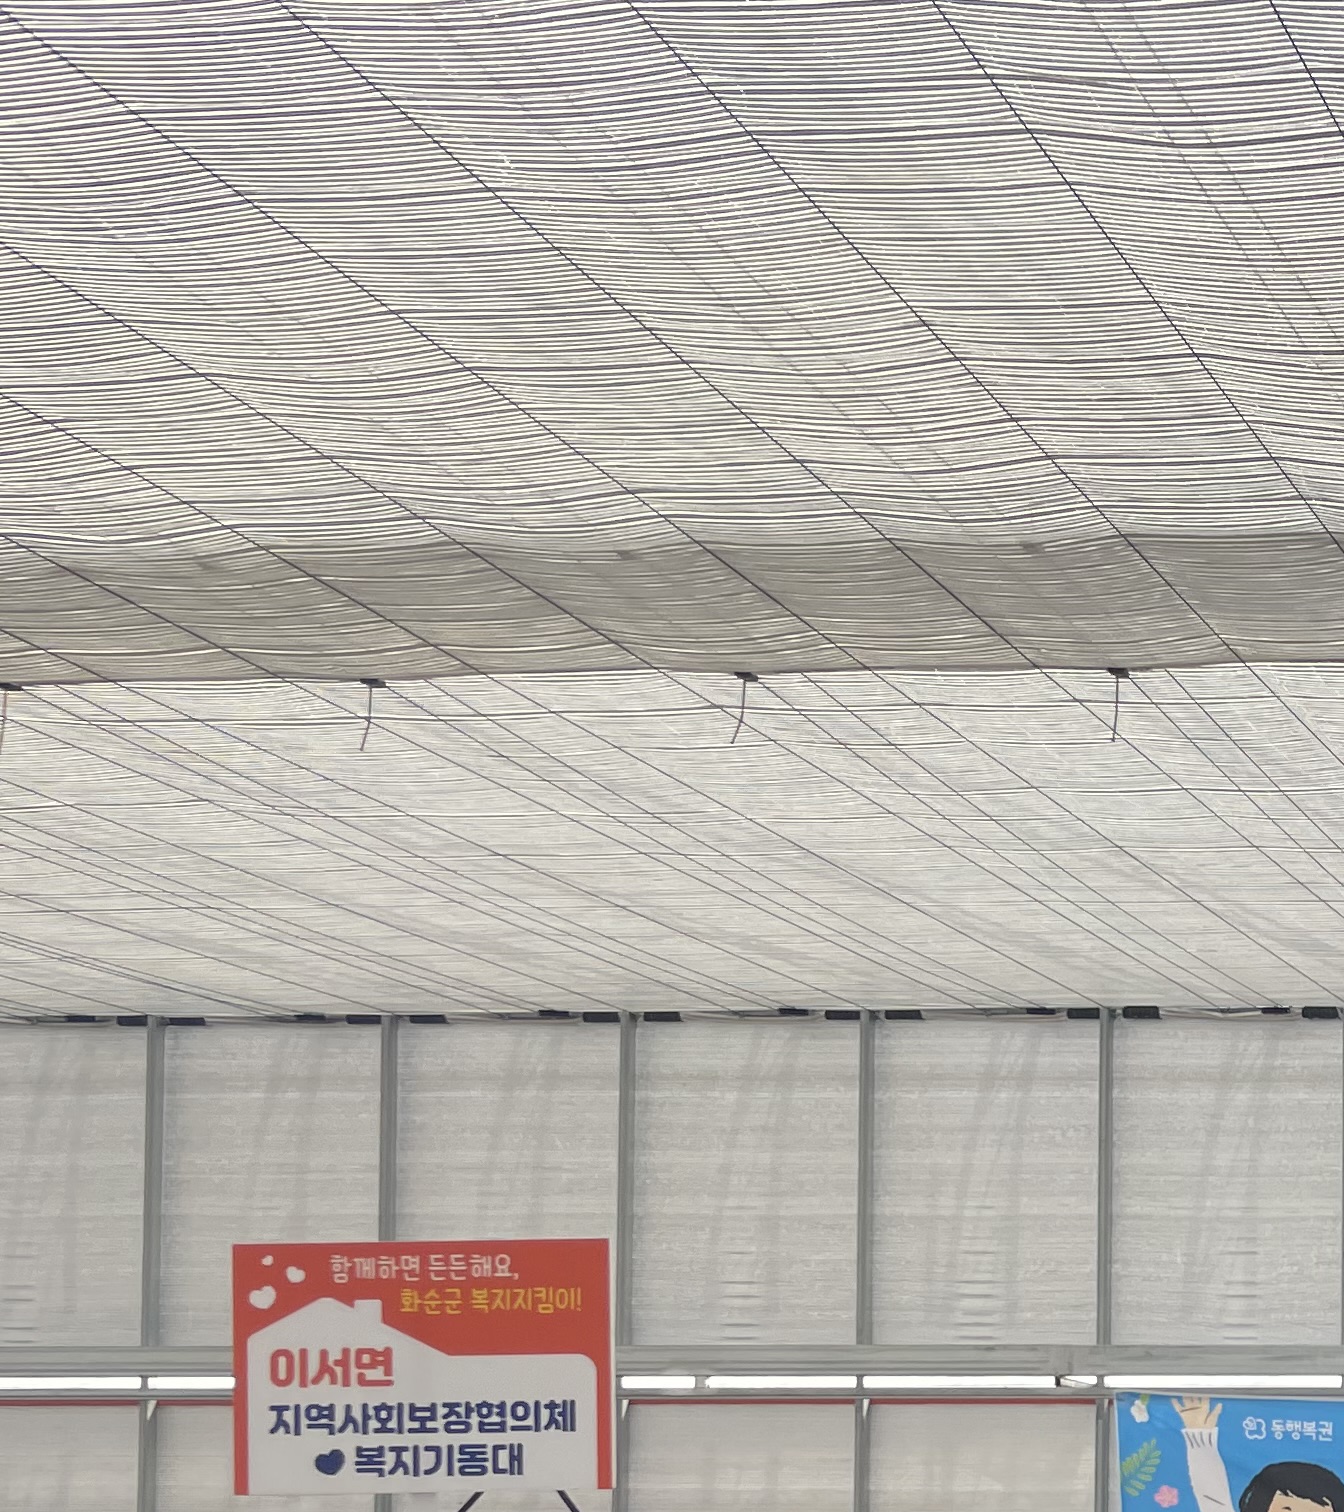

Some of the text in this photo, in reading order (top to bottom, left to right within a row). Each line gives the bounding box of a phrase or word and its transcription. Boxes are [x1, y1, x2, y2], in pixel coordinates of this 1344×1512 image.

[329, 1253, 519, 1284] 함께하면 든든해요,
[400, 1287, 582, 1315] 화순군 복지지킴이!
[269, 1346, 395, 1388] 이서면
[268, 1400, 577, 1436] 지역사회보장협의체
[1270, 1418, 1334, 1442] 동행복권
[354, 1443, 525, 1477] 복지기동대
